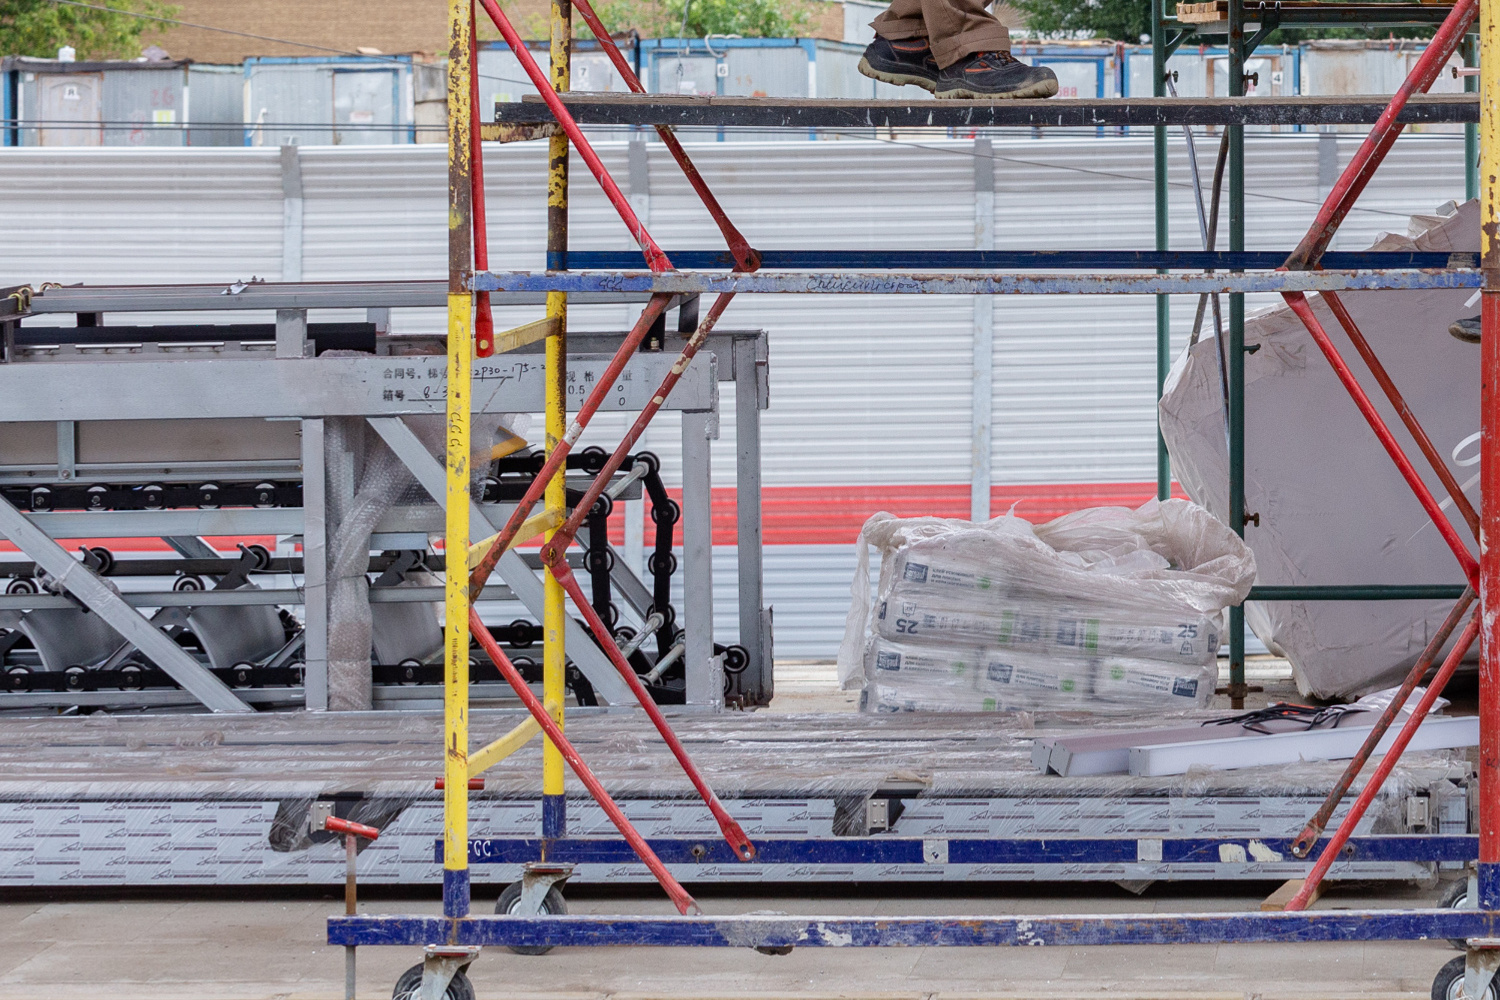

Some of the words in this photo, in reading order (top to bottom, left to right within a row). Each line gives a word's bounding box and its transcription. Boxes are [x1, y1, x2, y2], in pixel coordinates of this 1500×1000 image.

[580, 67, 587, 76] 7
[719, 66, 726, 75] 6
[1273, 73, 1281, 82] 4
[567, 384, 586, 395] 0.5
[896, 618, 919, 634] 25
[1177, 624, 1198, 638] 25
